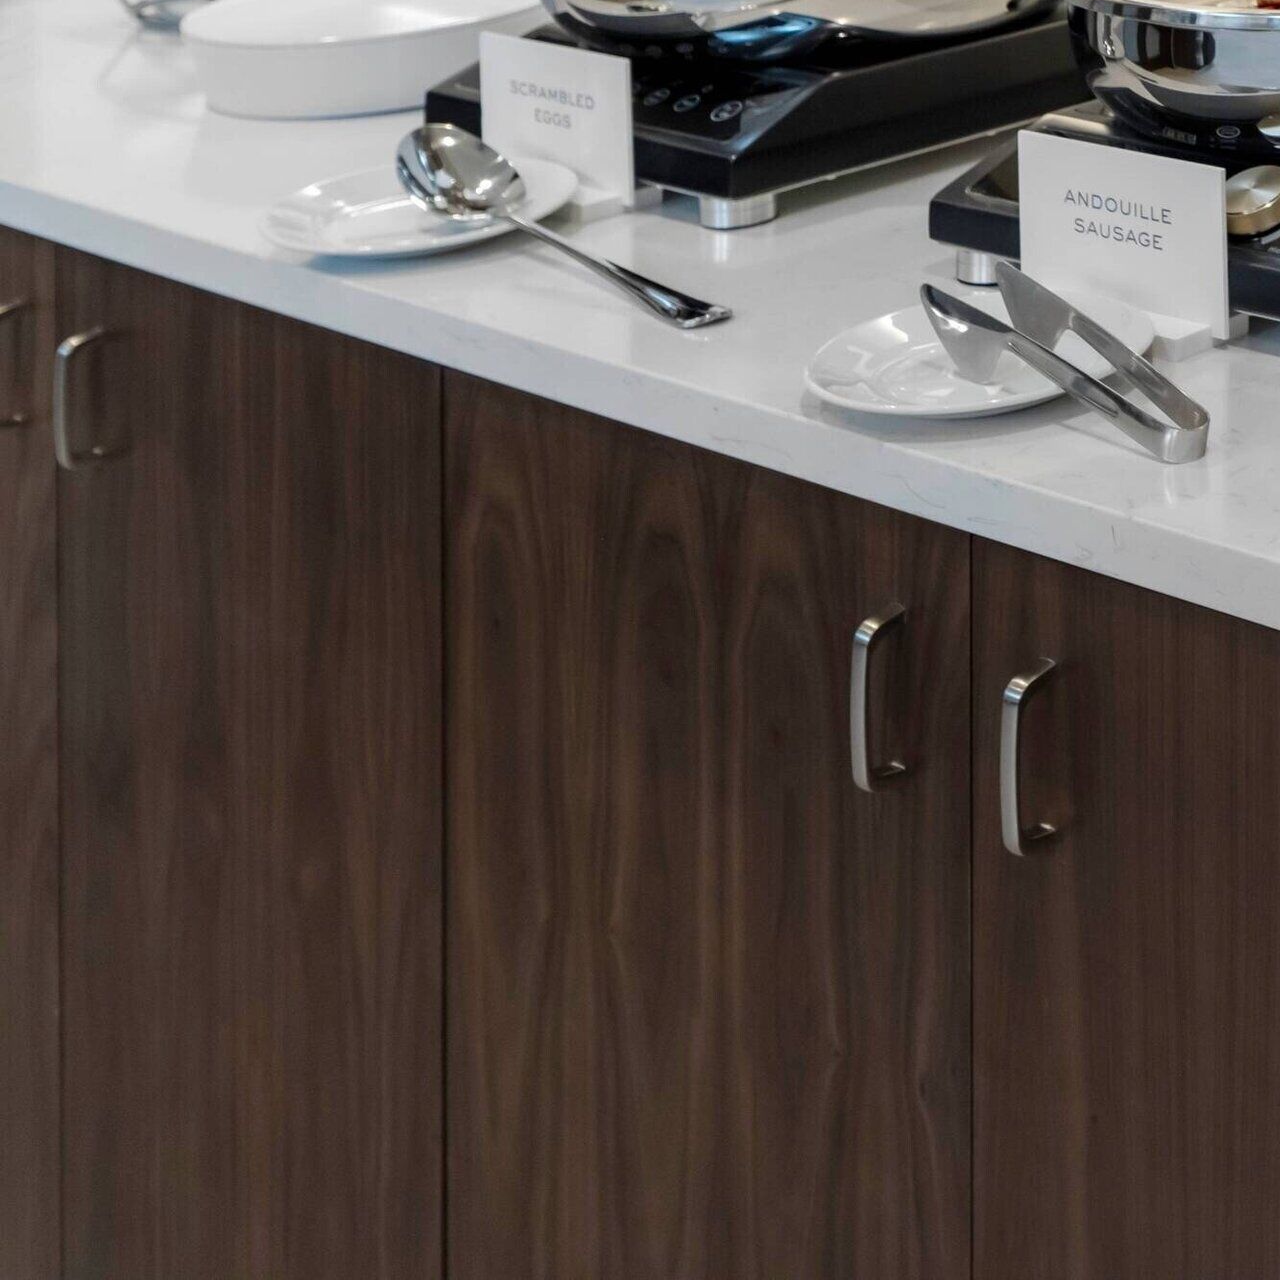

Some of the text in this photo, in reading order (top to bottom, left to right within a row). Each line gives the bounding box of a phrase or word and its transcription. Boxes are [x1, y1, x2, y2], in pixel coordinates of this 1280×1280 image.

[510, 80, 596, 111] SCRAMBLED
[535, 108, 572, 130] EGGS
[1064, 189, 1172, 225] ANDOUILLE
[1074, 218, 1164, 251] SAUSAGE
